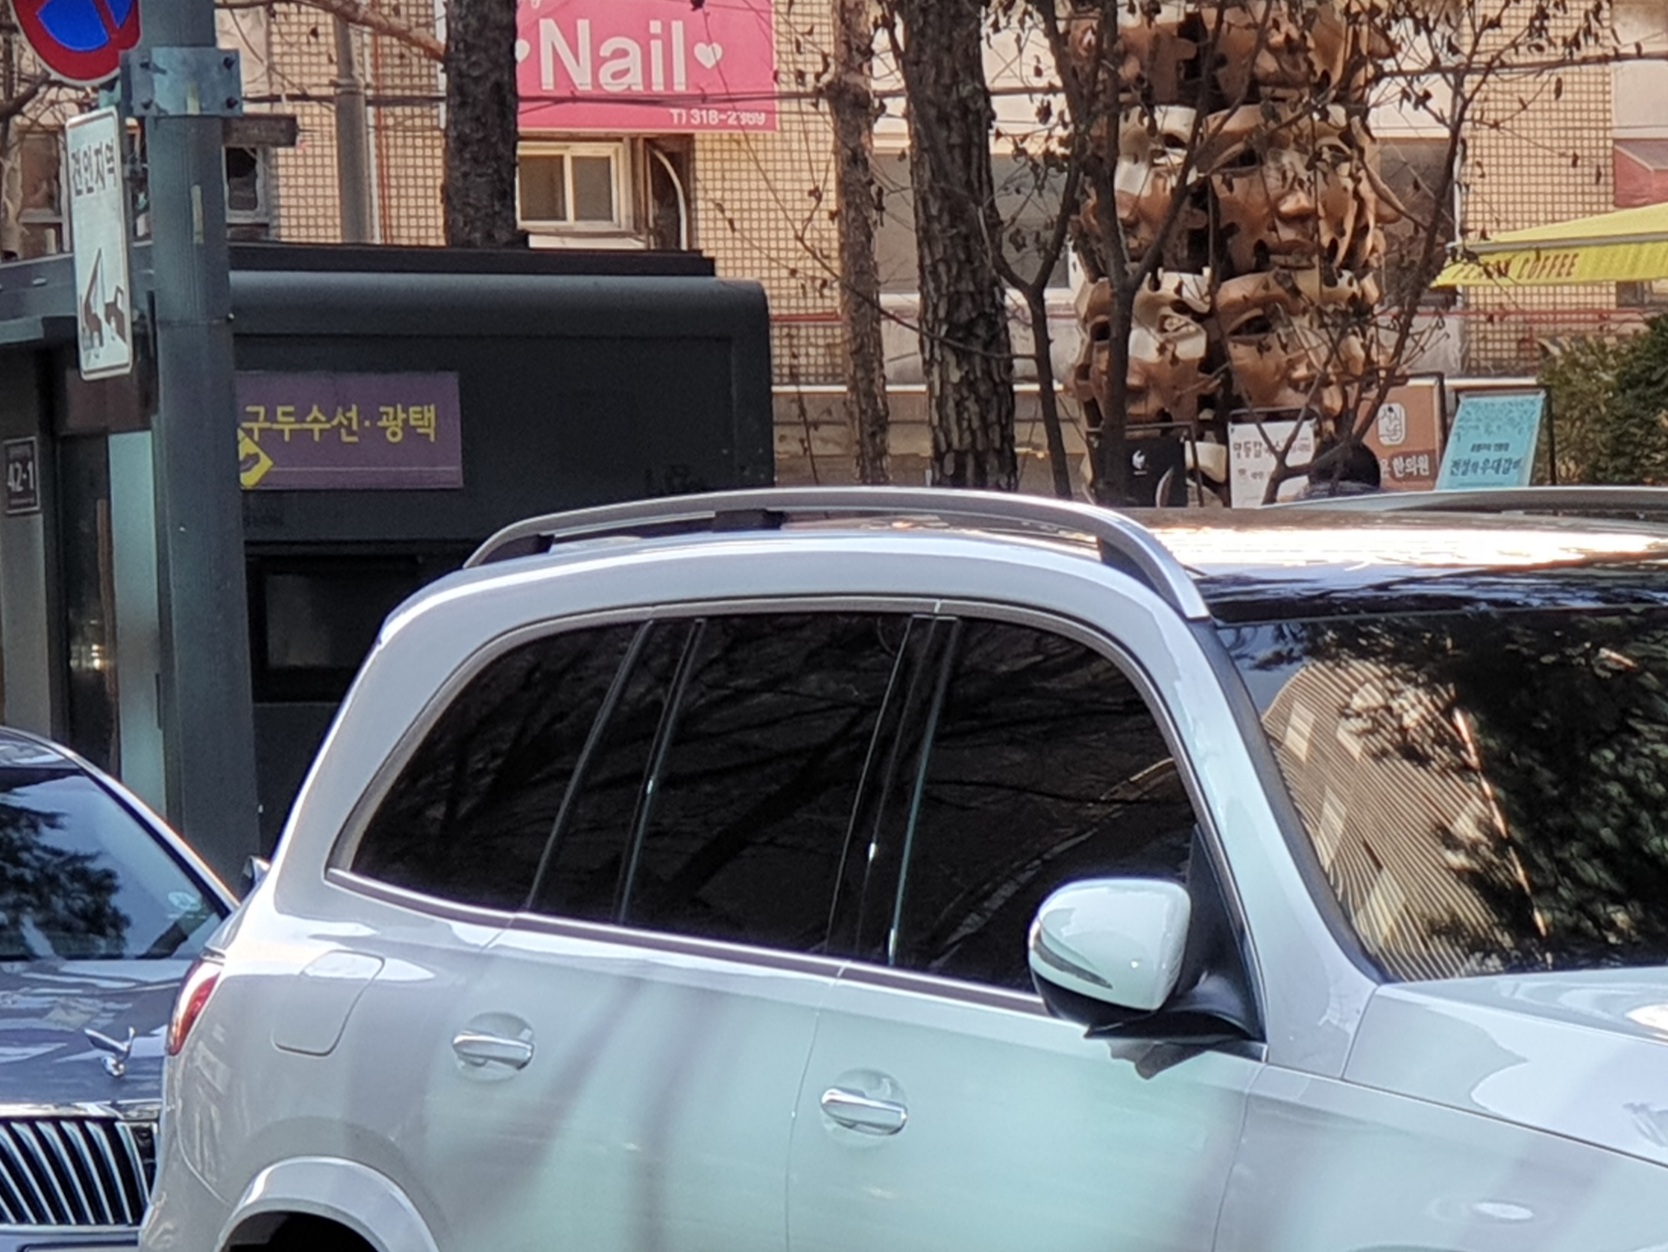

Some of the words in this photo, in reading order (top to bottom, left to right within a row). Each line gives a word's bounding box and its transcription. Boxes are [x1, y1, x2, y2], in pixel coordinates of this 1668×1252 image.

[539, 18, 688, 92] Nail
[70, 136, 117, 197] 견인지역
[1391, 454, 1431, 478] 한의원
